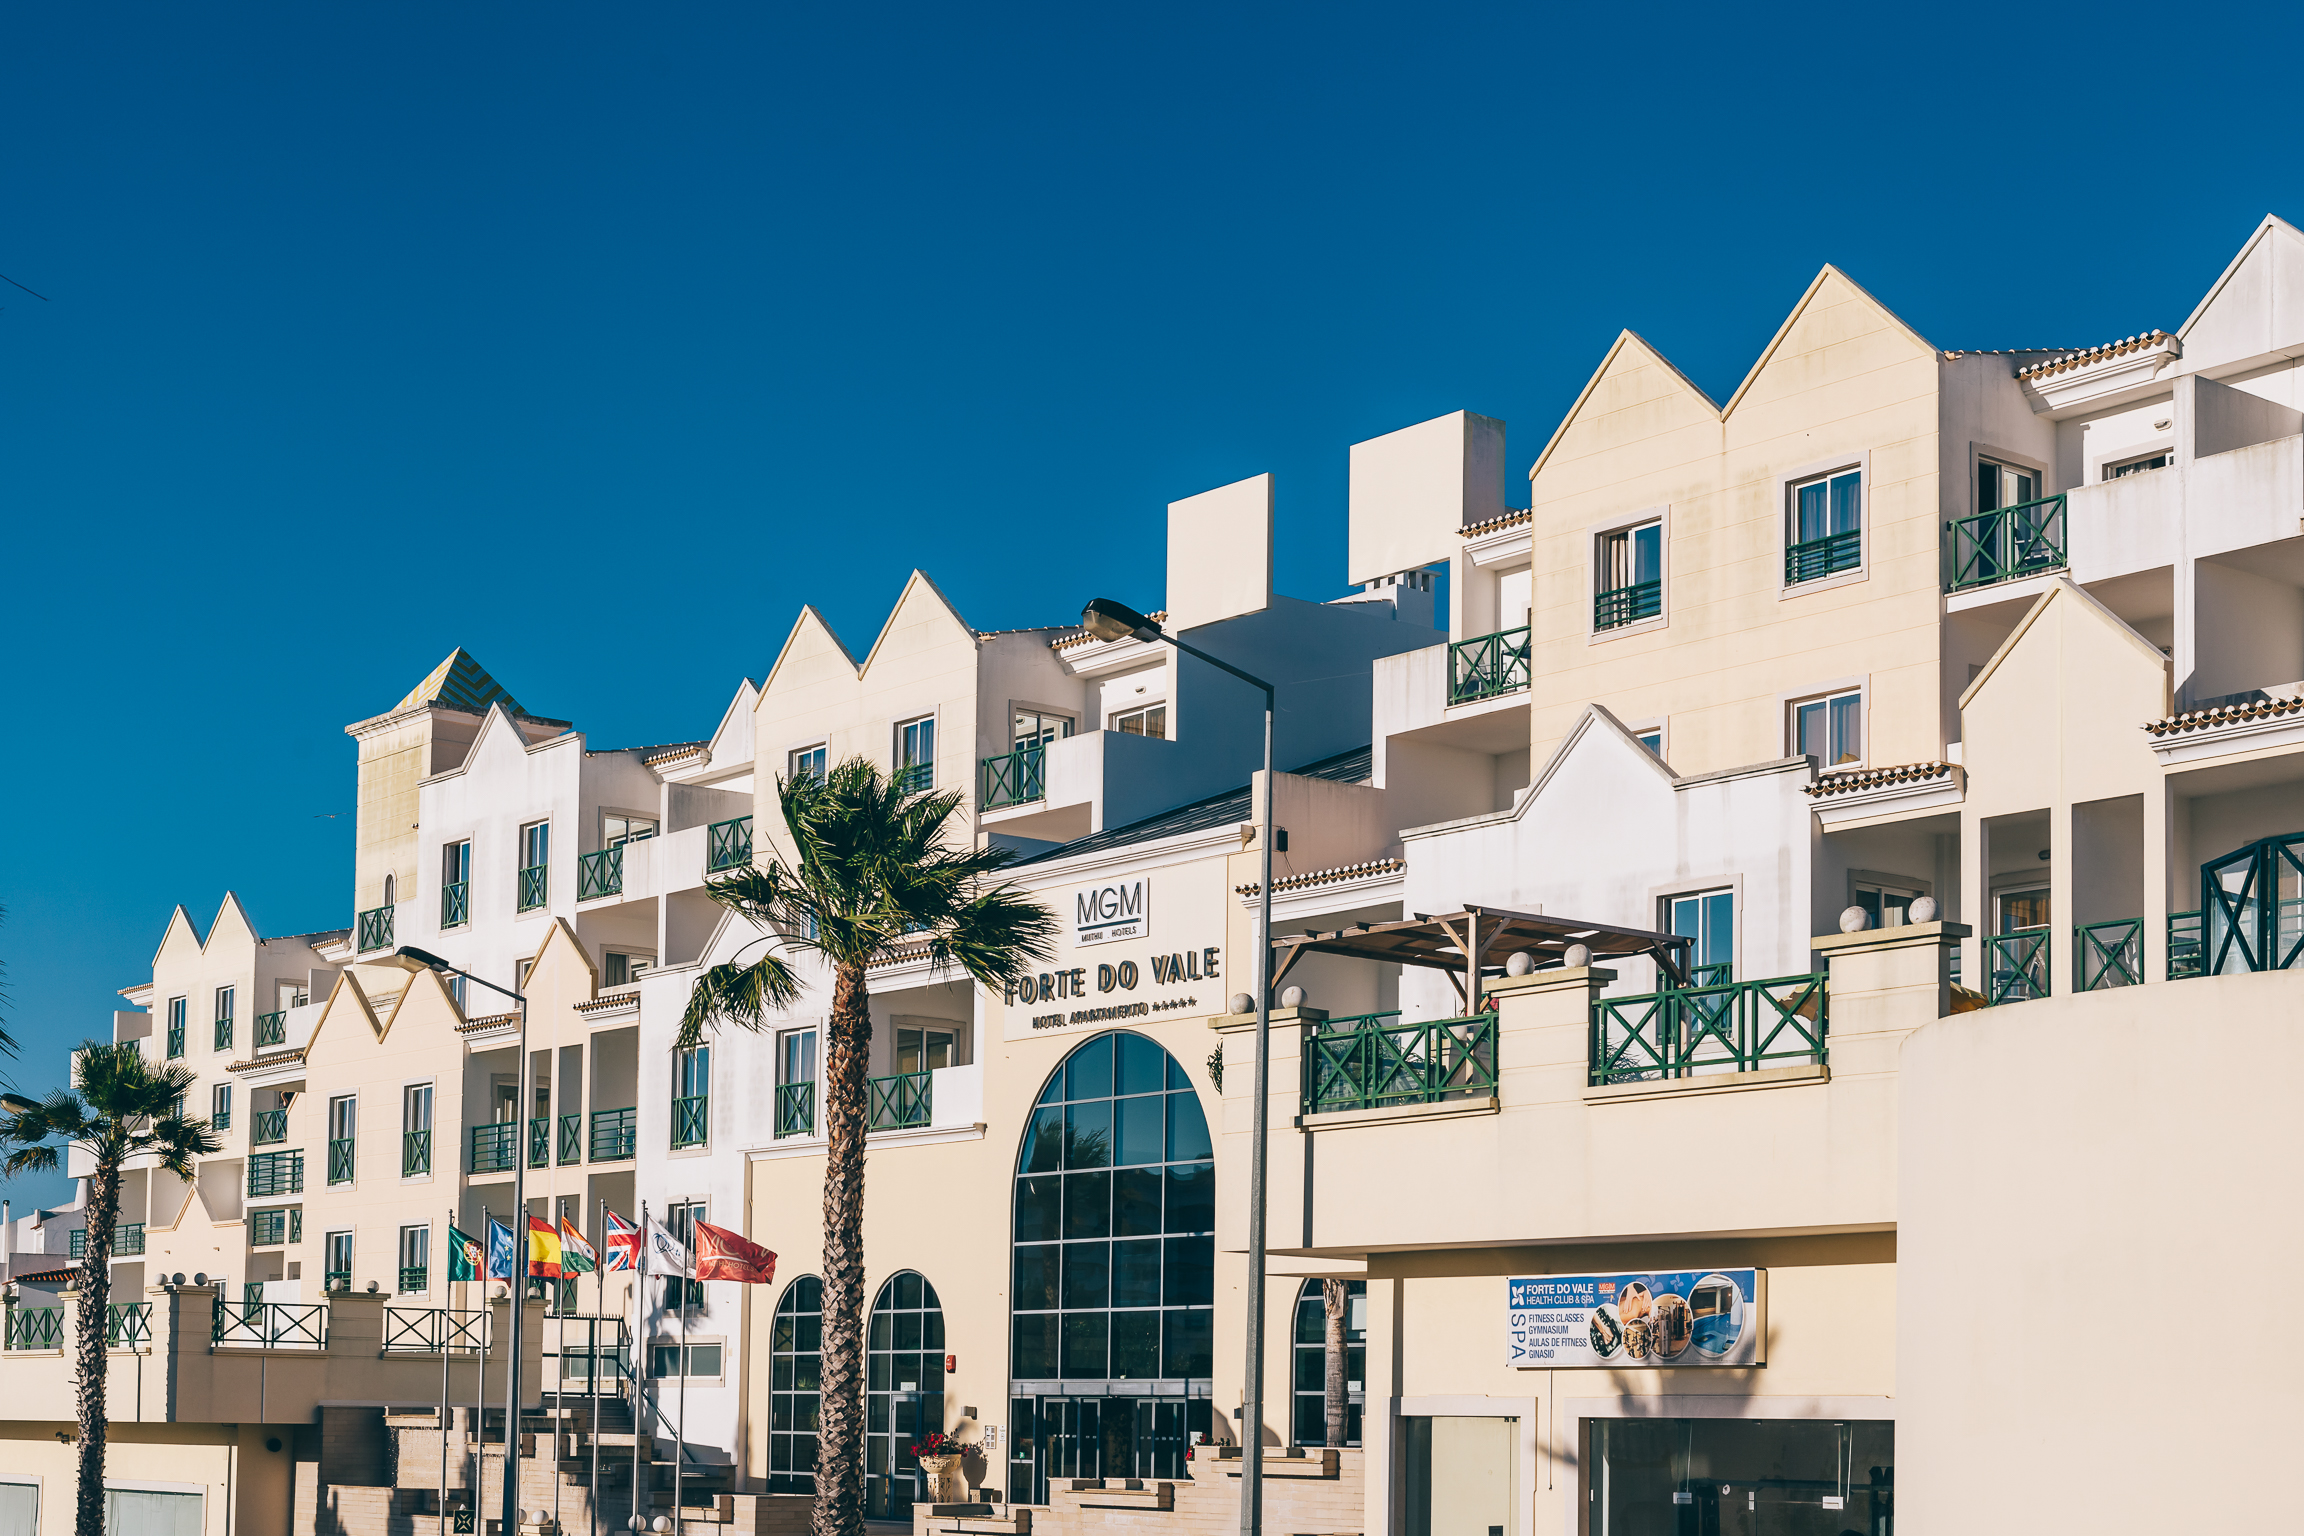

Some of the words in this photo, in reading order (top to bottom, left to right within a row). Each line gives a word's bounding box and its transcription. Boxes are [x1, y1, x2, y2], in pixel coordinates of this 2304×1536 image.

[1077, 882, 1142, 924] MGM
[1111, 926, 1137, 937] HOTELS
[1004, 967, 1086, 1007] FORTE
[1097, 960, 1139, 993] DO
[1150, 946, 1221, 986] VALE
[1032, 1013, 1067, 1030] HOTEL
[1069, 1002, 1149, 1025] APARTAMENTO
[1526, 1284, 1555, 1295] FORTE
[1556, 1283, 1571, 1294] DO
[1571, 1283, 1594, 1294] VALE
[1526, 1296, 1553, 1305] HEALTH
[1554, 1295, 1575, 1305] CLUB
[1575, 1295, 1580, 1304] &
[1581, 1295, 1595, 1304] SPA
[1528, 1313, 1555, 1323] FITNESS
[1556, 1313, 1585, 1323] CLASSES
[1528, 1325, 1569, 1335] GYMNASIUM
[1511, 1313, 1526, 1360] SPA
[1528, 1337, 1550, 1347] AULAS
[1551, 1337, 1560, 1347] DE
[1561, 1337, 1588, 1347] FITNESS
[1528, 1349, 1555, 1359] GINASIO
